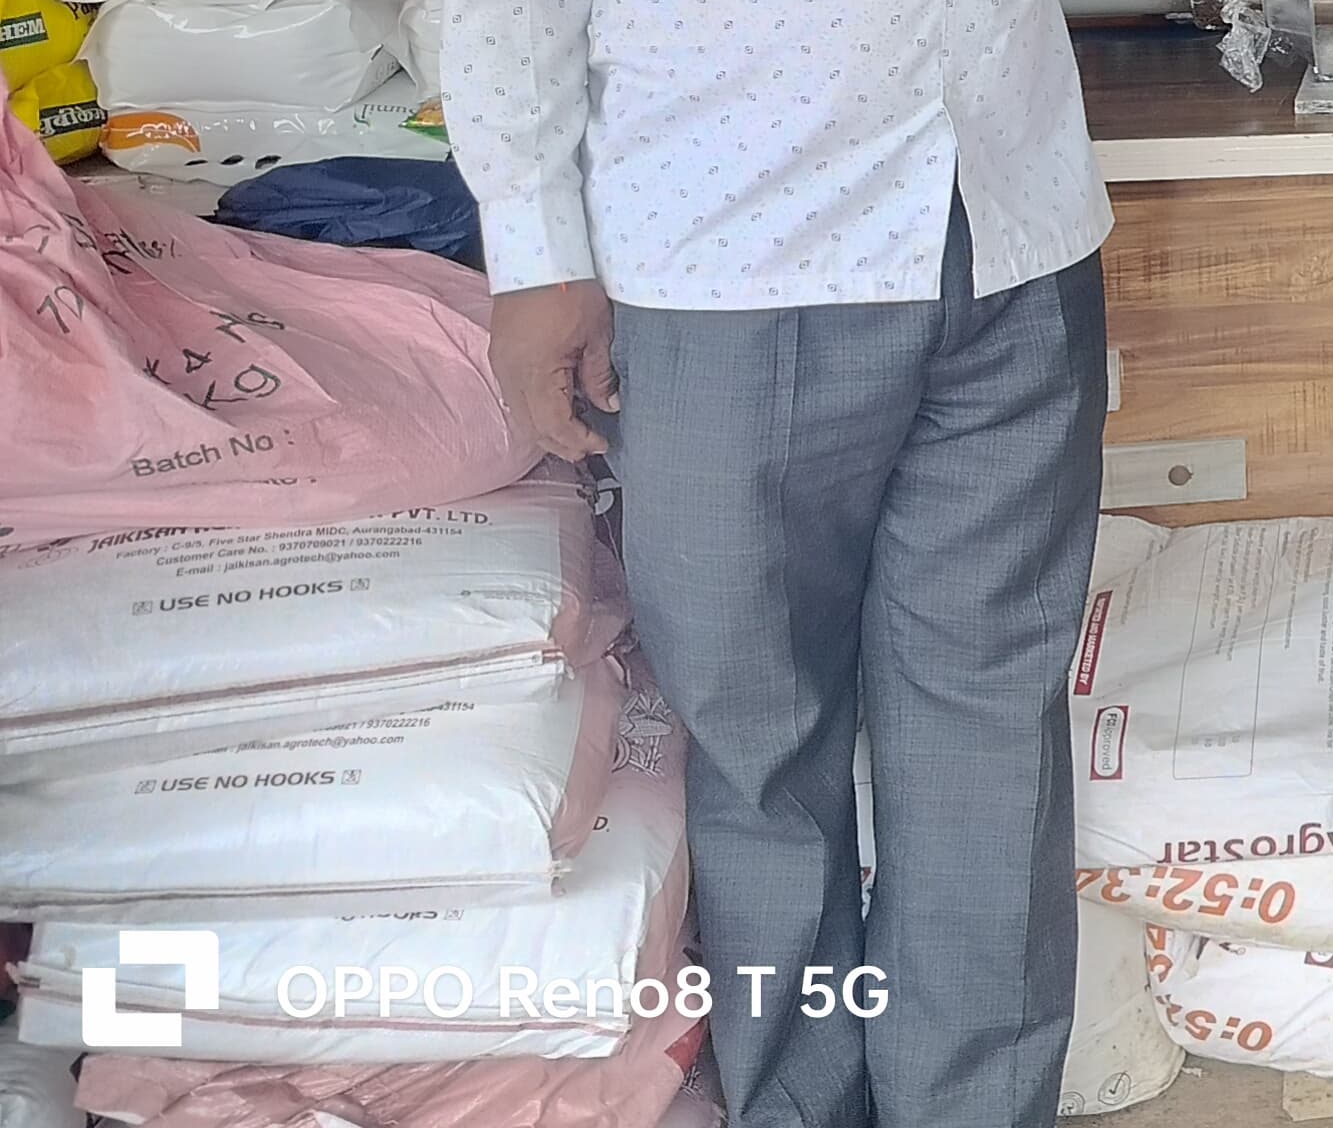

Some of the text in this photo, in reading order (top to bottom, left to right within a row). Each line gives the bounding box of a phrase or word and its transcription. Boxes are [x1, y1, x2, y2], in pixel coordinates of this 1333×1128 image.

[131, 443, 222, 478] Batch
[229, 432, 275, 458] No
[446, 508, 494, 527] LTD.
[115, 544, 161, 561] Factory
[209, 536, 233, 548] Five
[237, 533, 261, 544] Star
[263, 527, 313, 541] Shendra
[315, 525, 350, 538] MIDC,
[352, 523, 463, 539] Aurangabad-431154
[155, 551, 214, 567] Customer
[216, 547, 244, 559] Care
[245, 545, 269, 556] No.
[278, 539, 347, 552] 9370709021
[355, 536, 423, 548] 9370222216
[175, 563, 214, 578] E-mail
[223, 548, 401, 574] jaikisan.agrotech@yahoo.com
[159, 579, 344, 613] USE NO HOOKS
[366, 716, 432, 730] 9370222216
[161, 768, 336, 794] USE NO HOOKS
